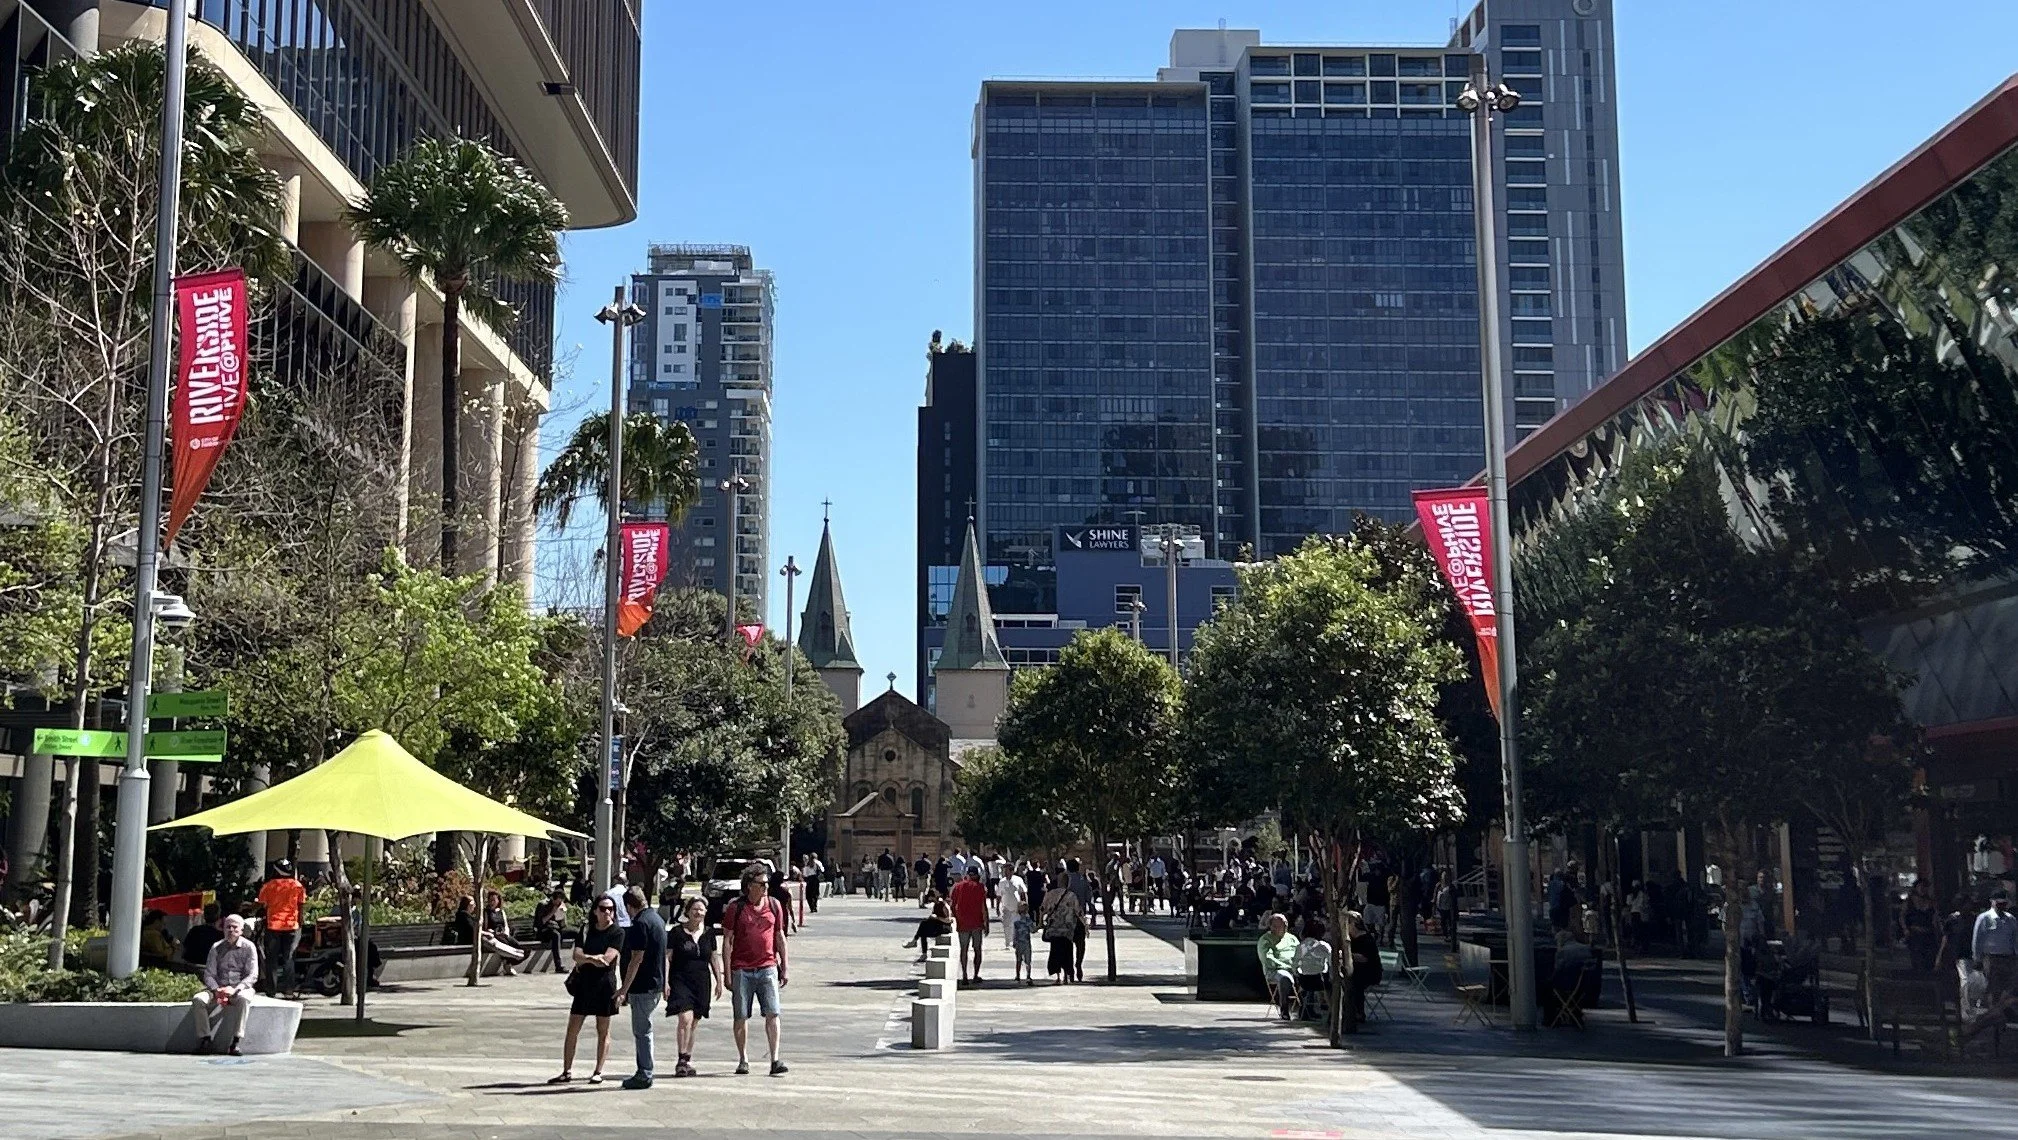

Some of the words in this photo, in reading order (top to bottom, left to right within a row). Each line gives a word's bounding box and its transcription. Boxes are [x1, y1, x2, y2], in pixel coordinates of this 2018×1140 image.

[188, 288, 224, 425] RIVERSIDE
[1089, 529, 1129, 540] SHINE
[1089, 540, 1130, 549] LAWYERS
